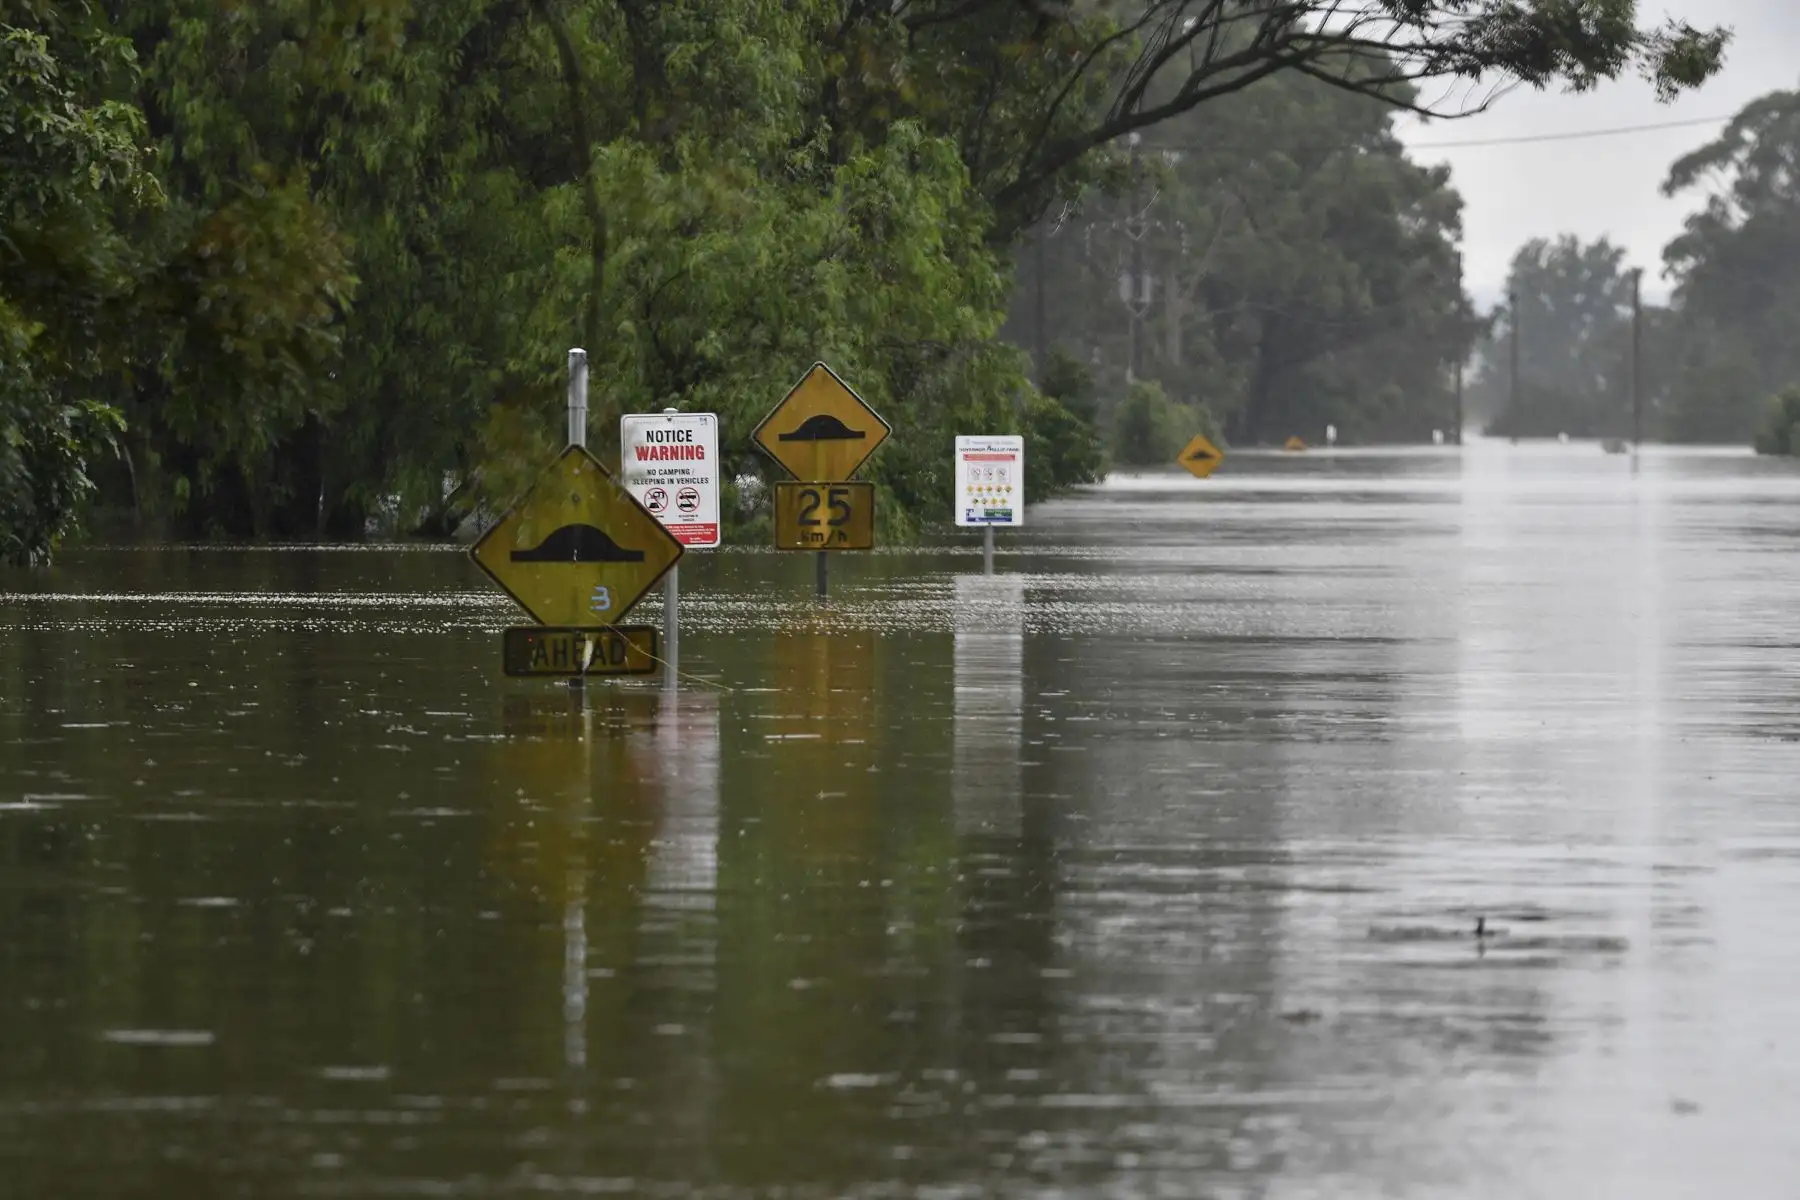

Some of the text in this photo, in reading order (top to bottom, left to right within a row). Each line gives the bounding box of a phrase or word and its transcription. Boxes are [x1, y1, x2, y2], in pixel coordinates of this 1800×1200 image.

[646, 430, 693, 443] NOTICE
[635, 445, 705, 461] WARNING
[658, 468, 690, 476] CAMPING
[676, 477, 709, 485] VEHICLES
[798, 489, 852, 526] 25
[801, 530, 848, 545] km/h
[533, 638, 626, 667] AHEAD
